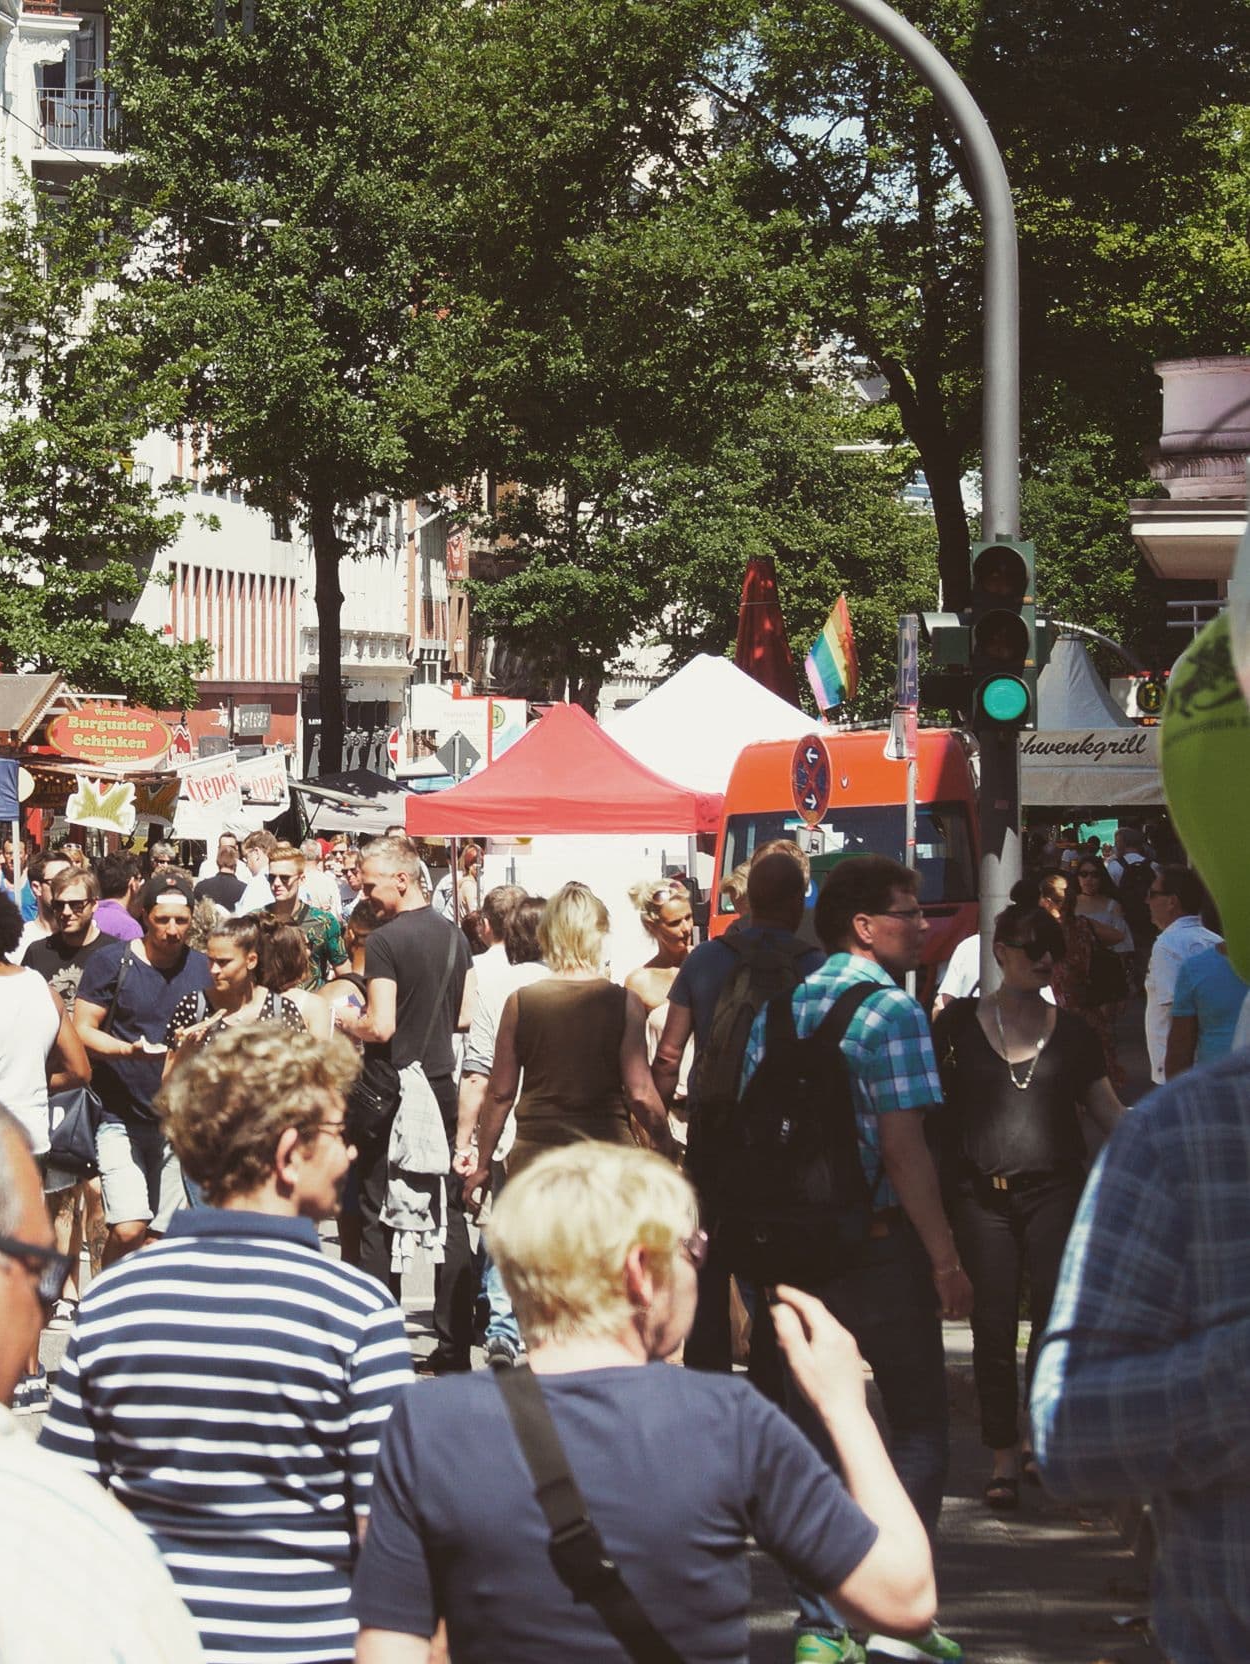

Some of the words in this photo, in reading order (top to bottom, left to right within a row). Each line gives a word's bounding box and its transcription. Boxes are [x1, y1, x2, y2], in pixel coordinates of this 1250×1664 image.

[67, 715, 155, 732] Burgunder
[72, 733, 147, 749] Schinken
[186, 771, 237, 801] Crêpes
